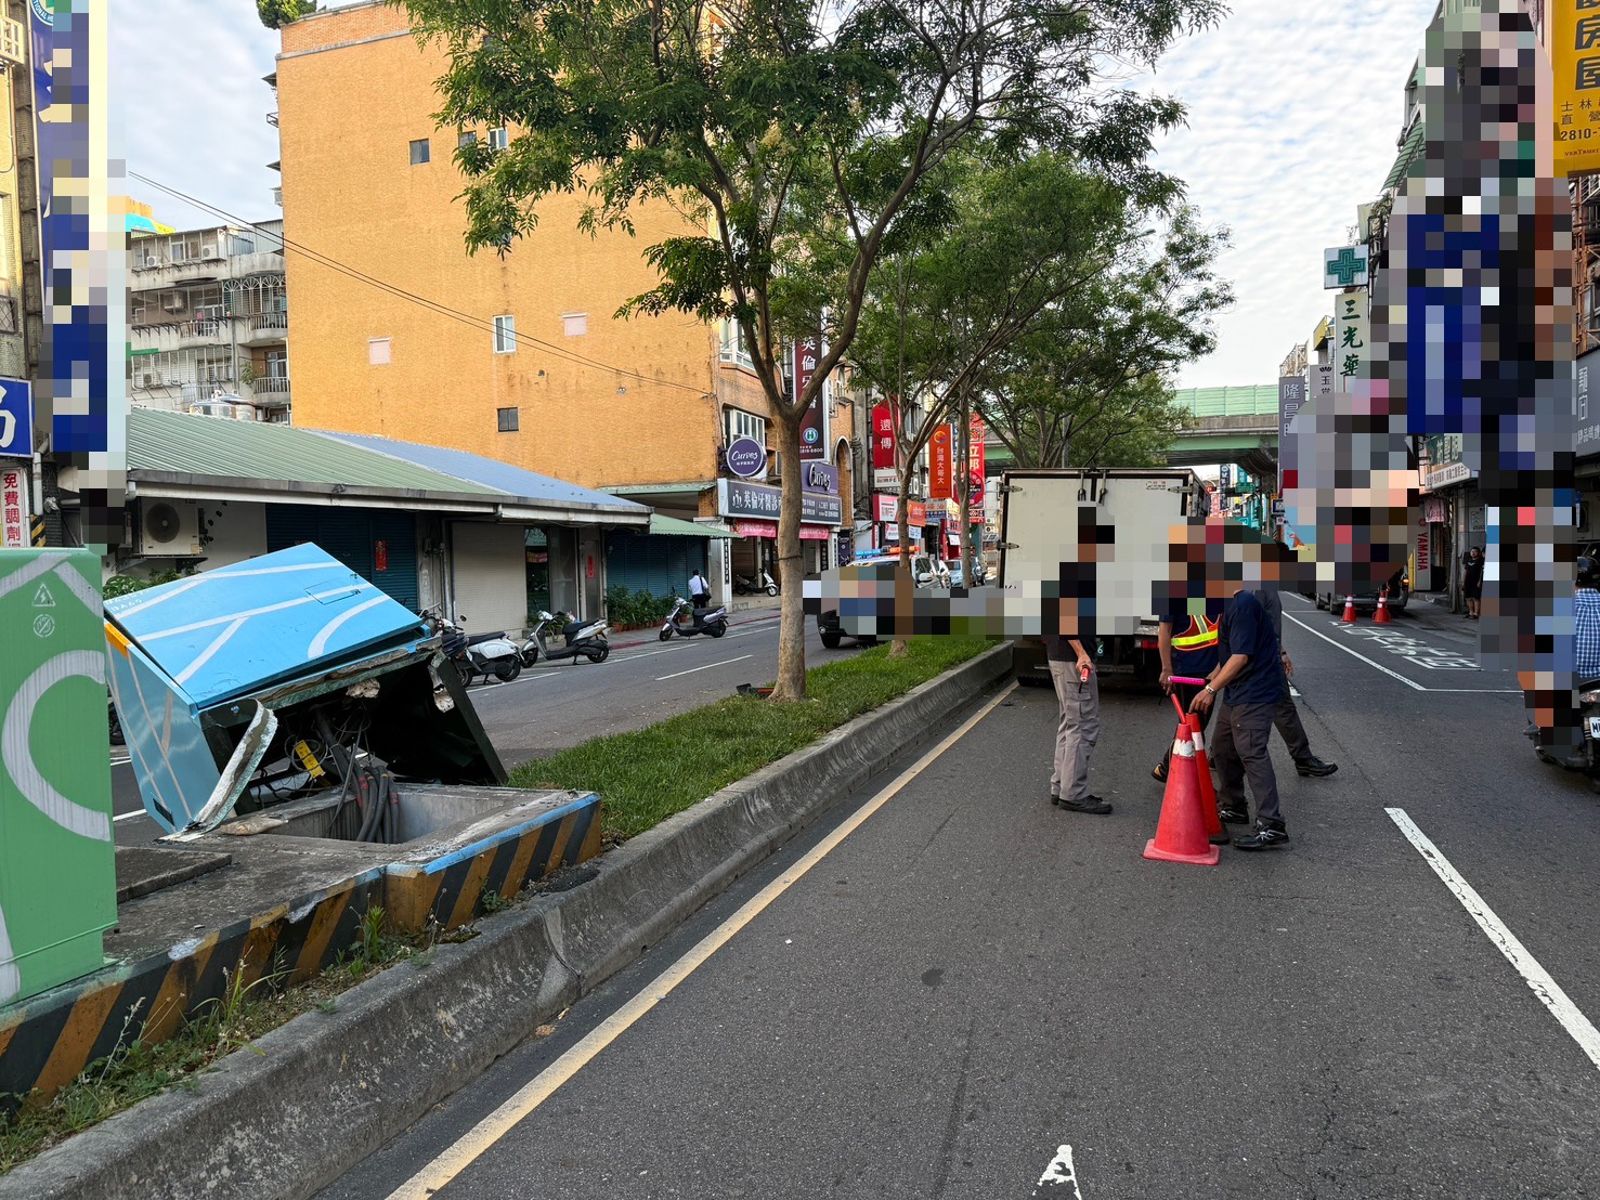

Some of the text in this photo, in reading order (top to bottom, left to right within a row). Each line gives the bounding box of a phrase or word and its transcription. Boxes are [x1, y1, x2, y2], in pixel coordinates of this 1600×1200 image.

[1575, 0, 1600, 91] 房屋
[1560, 97, 1600, 112] 士林
[731, 450, 759, 462] Curves
[809, 463, 831, 490] Curves
[3, 472, 21, 546] 免費調劑
[743, 489, 781, 511] 英倫牙醫診
[1417, 531, 1429, 571] YAMAHA
